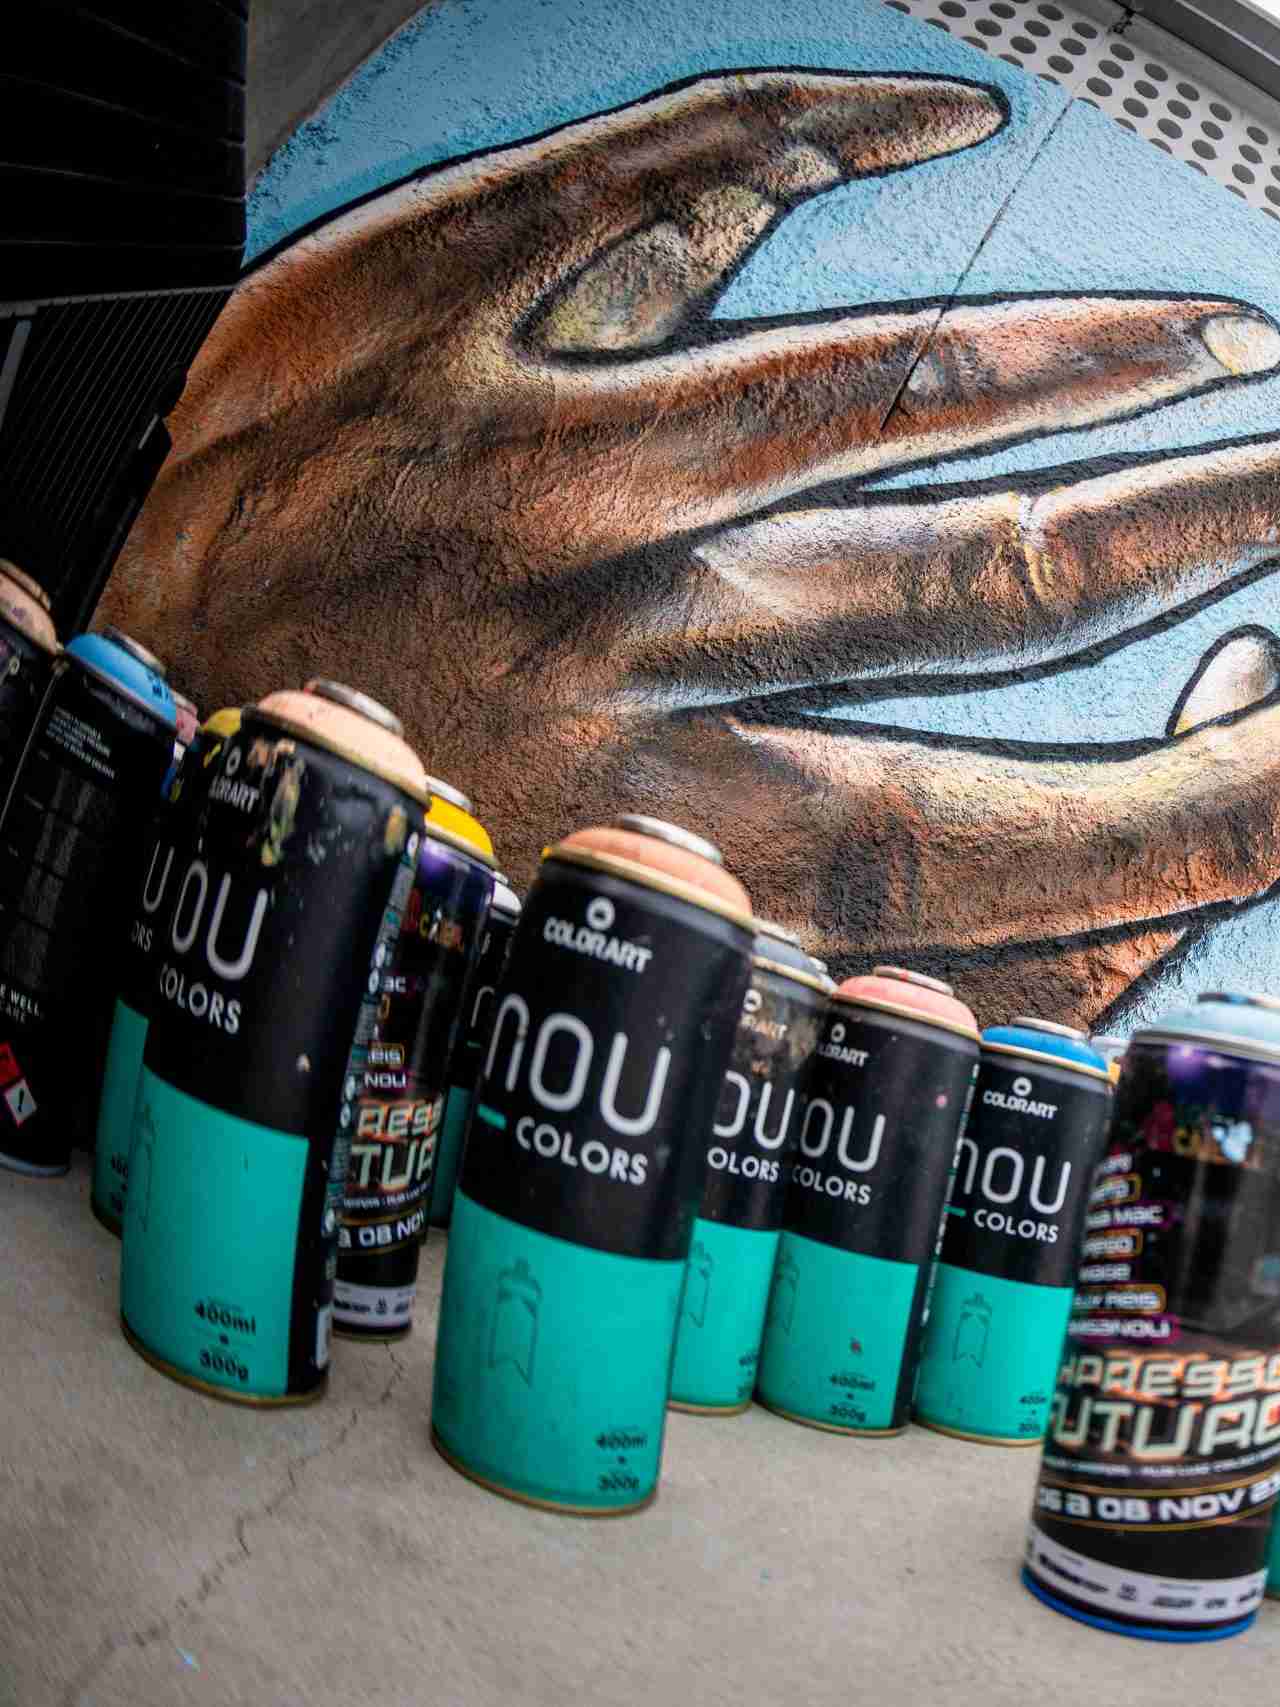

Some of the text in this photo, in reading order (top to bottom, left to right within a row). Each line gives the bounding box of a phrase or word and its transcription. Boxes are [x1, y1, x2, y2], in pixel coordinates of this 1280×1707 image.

[171, 859, 269, 981] ou
[543, 917, 653, 973] COLORART
[983, 1090, 1058, 1119] COLORART
[516, 1116, 648, 1186] COLORS
[706, 1147, 780, 1183] OLORS
[973, 1208, 1059, 1244] COLORS
[1096, 1496, 1150, 1522] 08
[1158, 1488, 1245, 1522] NOV
